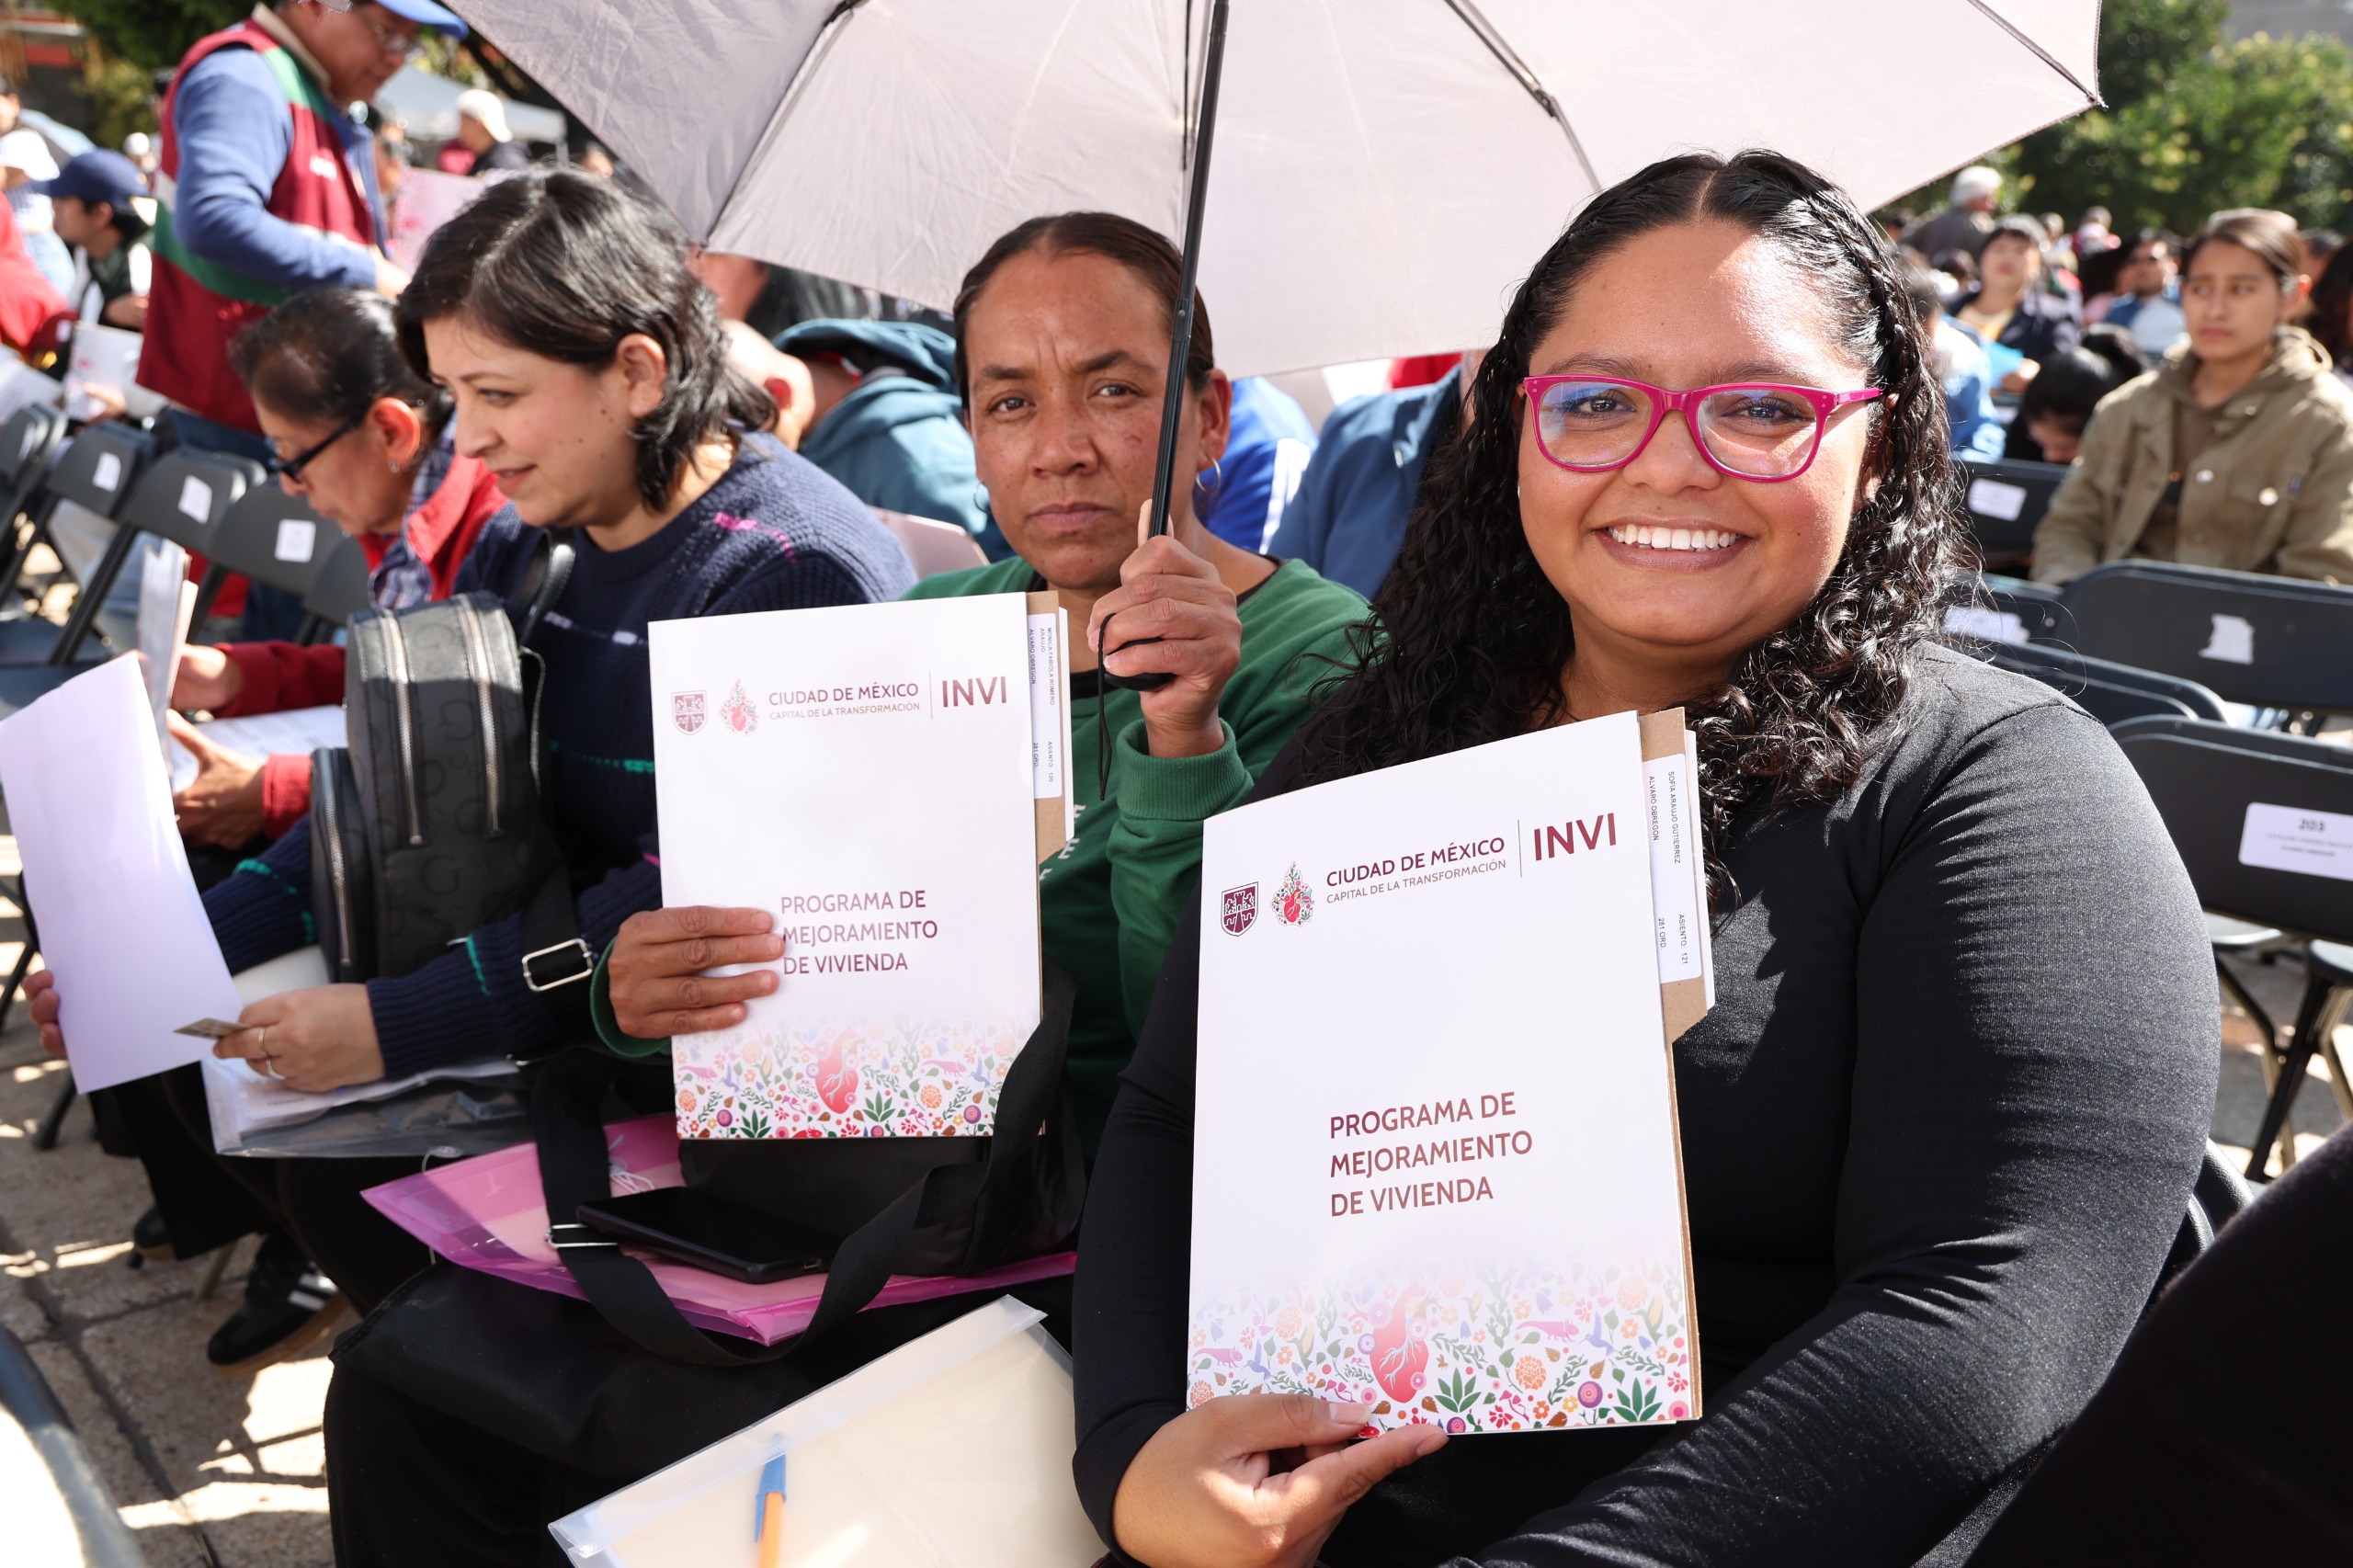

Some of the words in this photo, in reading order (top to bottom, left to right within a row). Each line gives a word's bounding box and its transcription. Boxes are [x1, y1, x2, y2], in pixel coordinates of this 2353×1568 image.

[768, 689, 828, 706] CIUDAD
[833, 687, 854, 701] DE
[858, 682, 919, 699] MÉXICO
[941, 676, 1007, 708] INVI
[769, 710, 806, 720] CAPITAL
[807, 709, 820, 718] DE
[822, 709, 834, 717] LA
[835, 701, 920, 715] TRANSFORMACIÓN
[1649, 776, 1657, 804] ALVARO
[1667, 771, 1676, 793] SOFIA
[1651, 805, 1659, 841] OBREGON
[1669, 793, 1678, 823] ARAUJO
[1533, 812, 1617, 861] INVI
[1671, 823, 1681, 864] GUTIERREZ
[1326, 859, 1395, 887] CIUDAD
[1401, 853, 1426, 871] DE
[1430, 837, 1505, 866] MÉXICO
[1326, 887, 1368, 903] CAPITAL
[1370, 883, 1385, 894] DE
[1387, 881, 1401, 892] LA
[1403, 858, 1506, 888] TRANSFORMACIÓN
[781, 892, 894, 914] PROGRAMA
[899, 890, 926, 909] DE
[782, 920, 938, 948] MEJORAMIENTO
[1678, 914, 1688, 949] ASIENTO:
[783, 956, 810, 974] DE
[814, 952, 909, 973] VIVIENDA
[1330, 1097, 1474, 1139] PROGRAMA
[1481, 1091, 1517, 1119] DE
[1330, 1130, 1533, 1178] MEJORAMIENTO
[1331, 1190, 1364, 1217] DE
[1370, 1176, 1495, 1212] VIVIENDA
